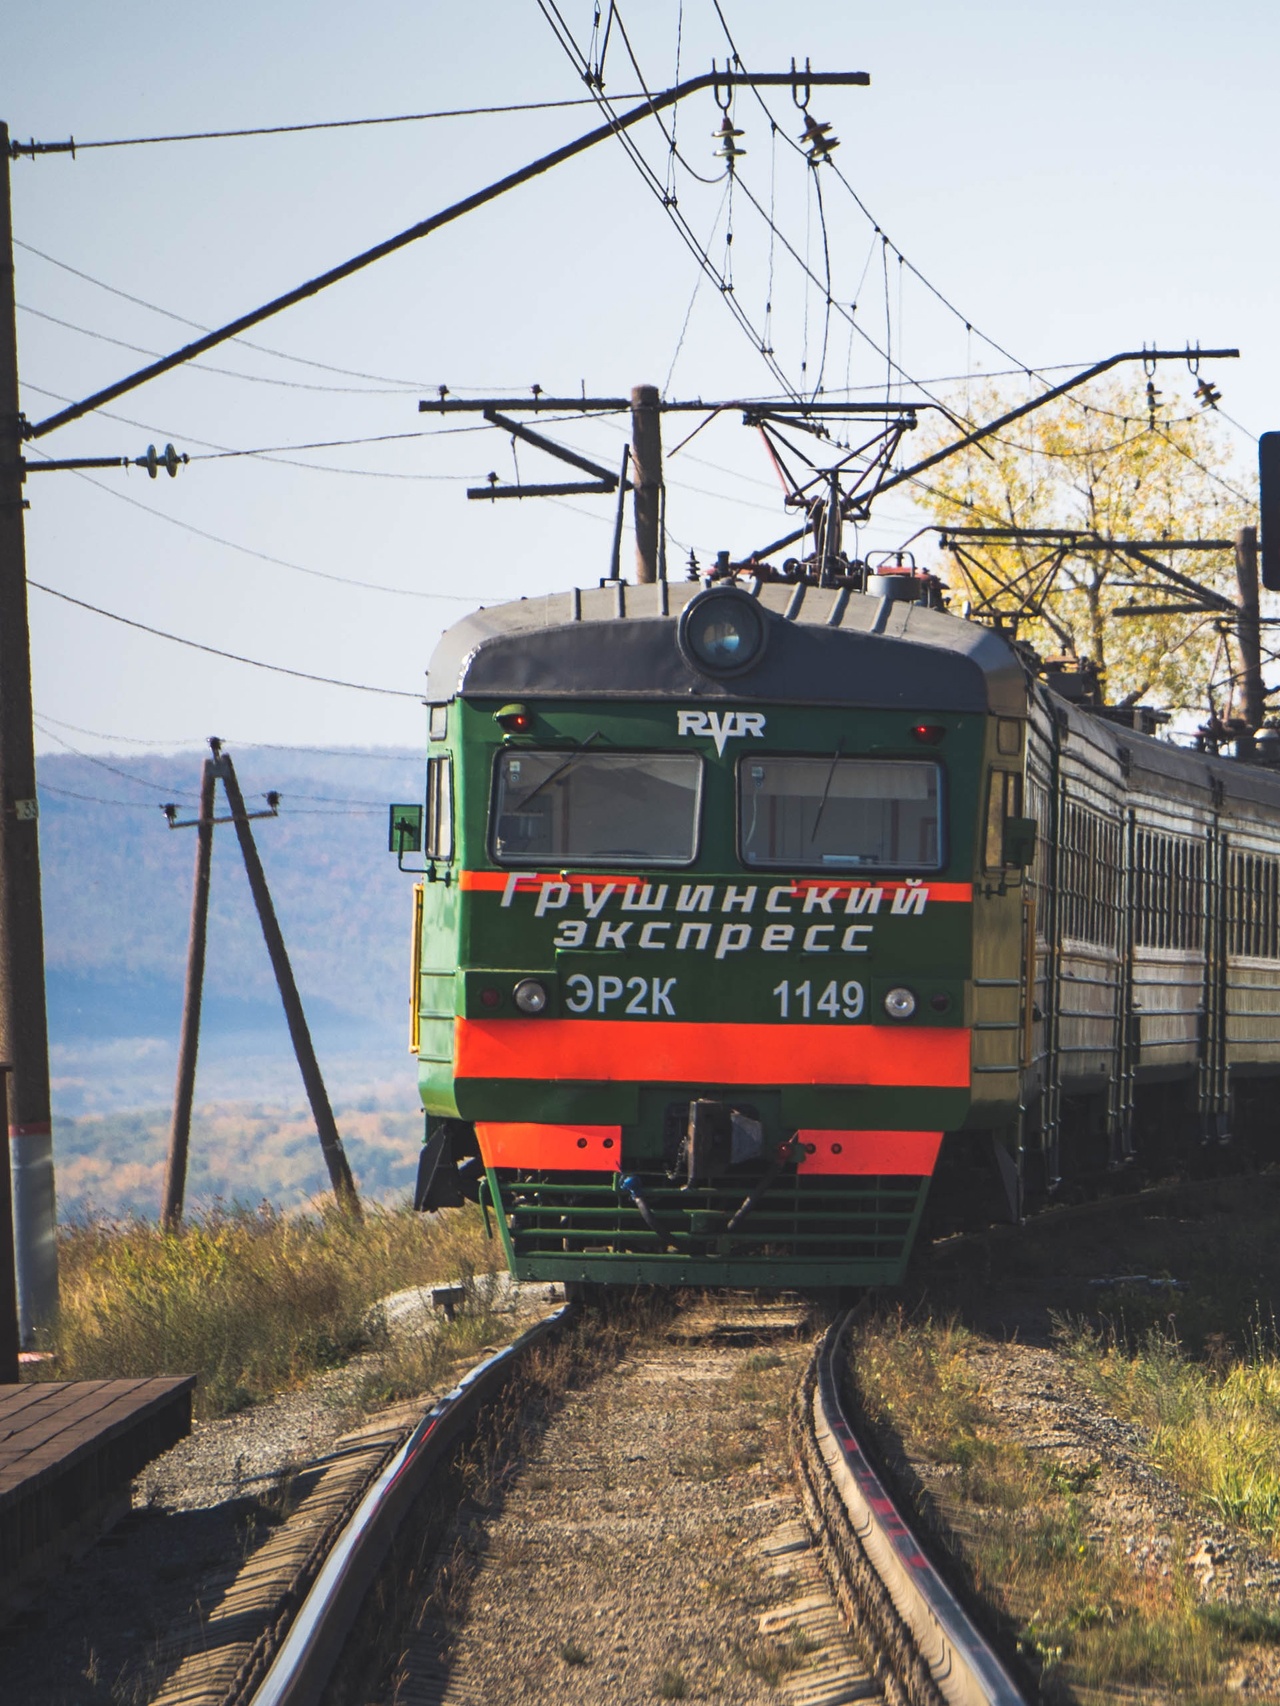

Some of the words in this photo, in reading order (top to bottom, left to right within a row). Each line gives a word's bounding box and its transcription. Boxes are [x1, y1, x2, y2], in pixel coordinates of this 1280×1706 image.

[677, 710, 766, 758] RVR
[500, 872, 929, 917] Грушинский
[554, 920, 873, 958] экспресс
[565, 974, 676, 1015] ЭР2К
[773, 980, 864, 1018] 1149
